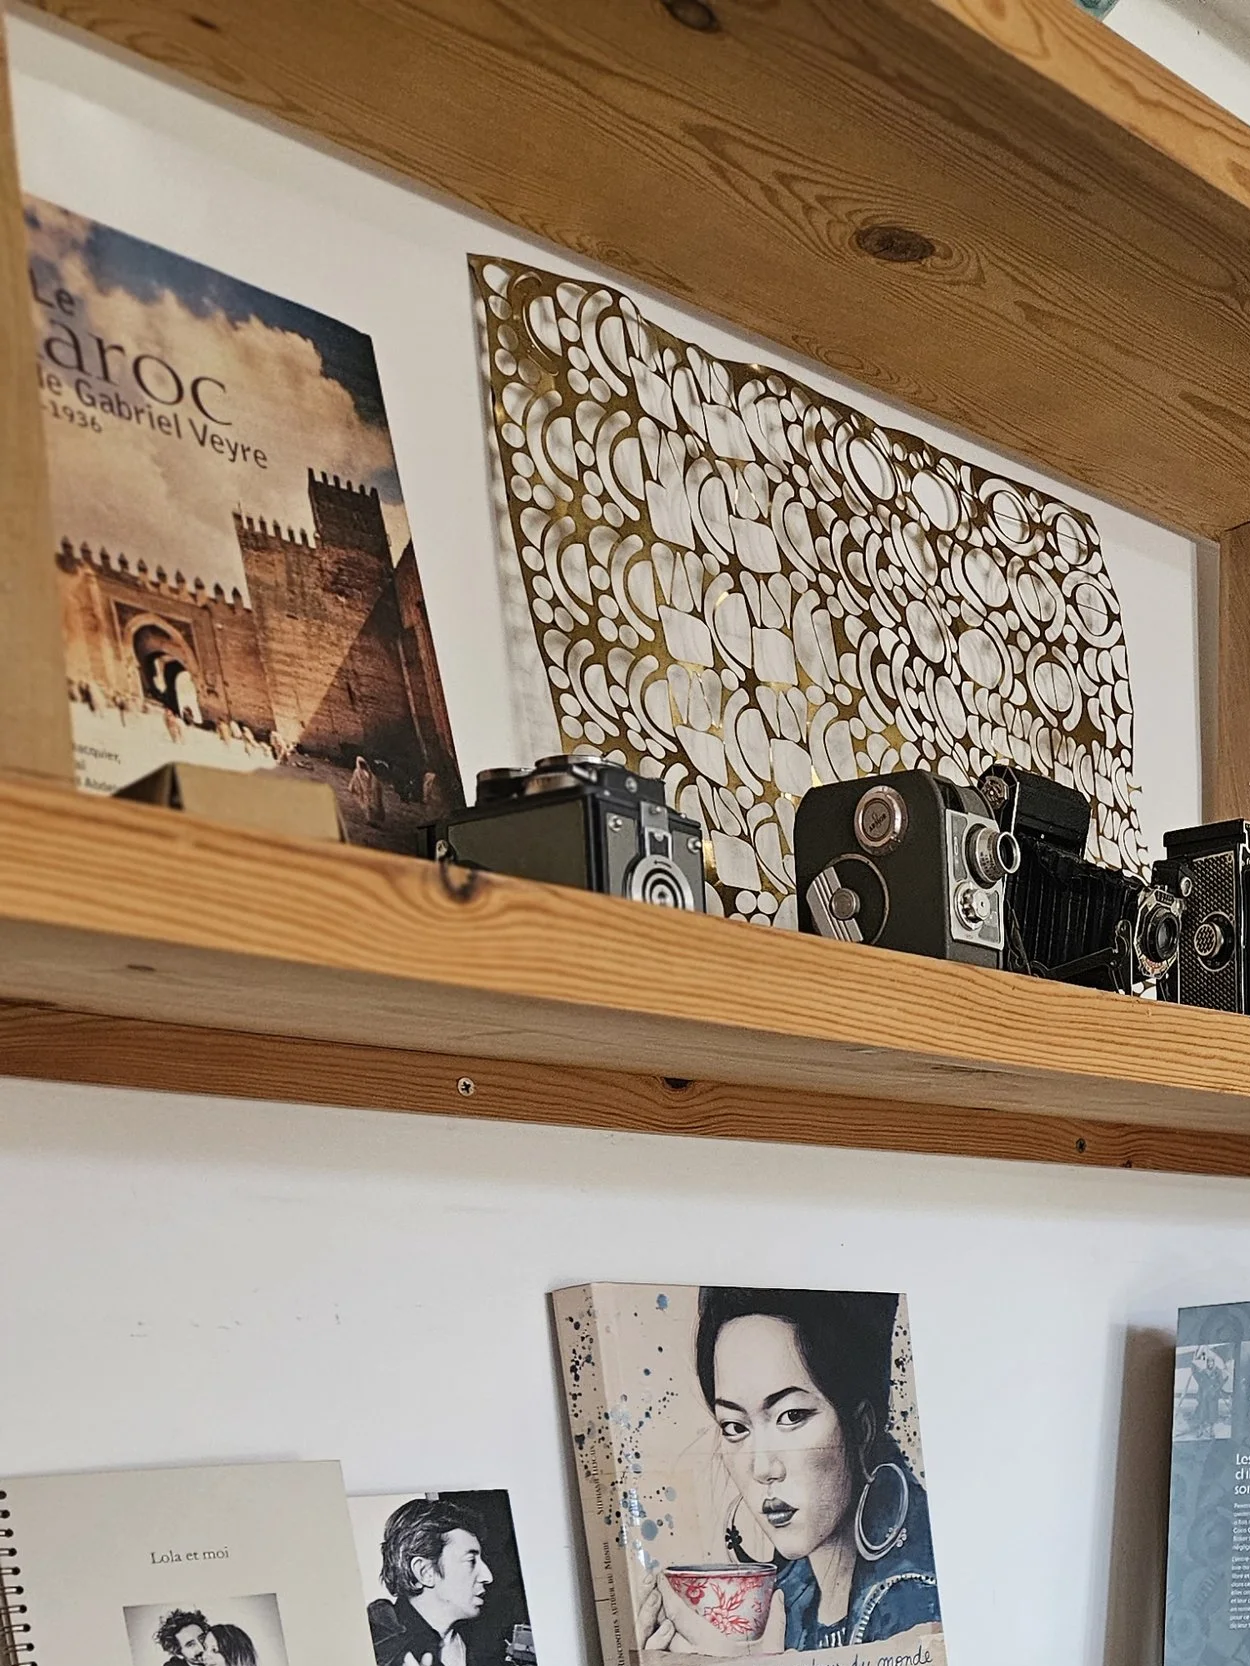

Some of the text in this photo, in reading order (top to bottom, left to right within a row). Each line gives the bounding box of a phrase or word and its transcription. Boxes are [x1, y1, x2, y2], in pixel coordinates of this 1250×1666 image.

[29, 267, 76, 316] Le
[37, 319, 233, 426] aroc
[75, 379, 182, 440] Gabriel
[188, 418, 268, 470] Veyre
[151, 1546, 229, 1564] Lola et moi
